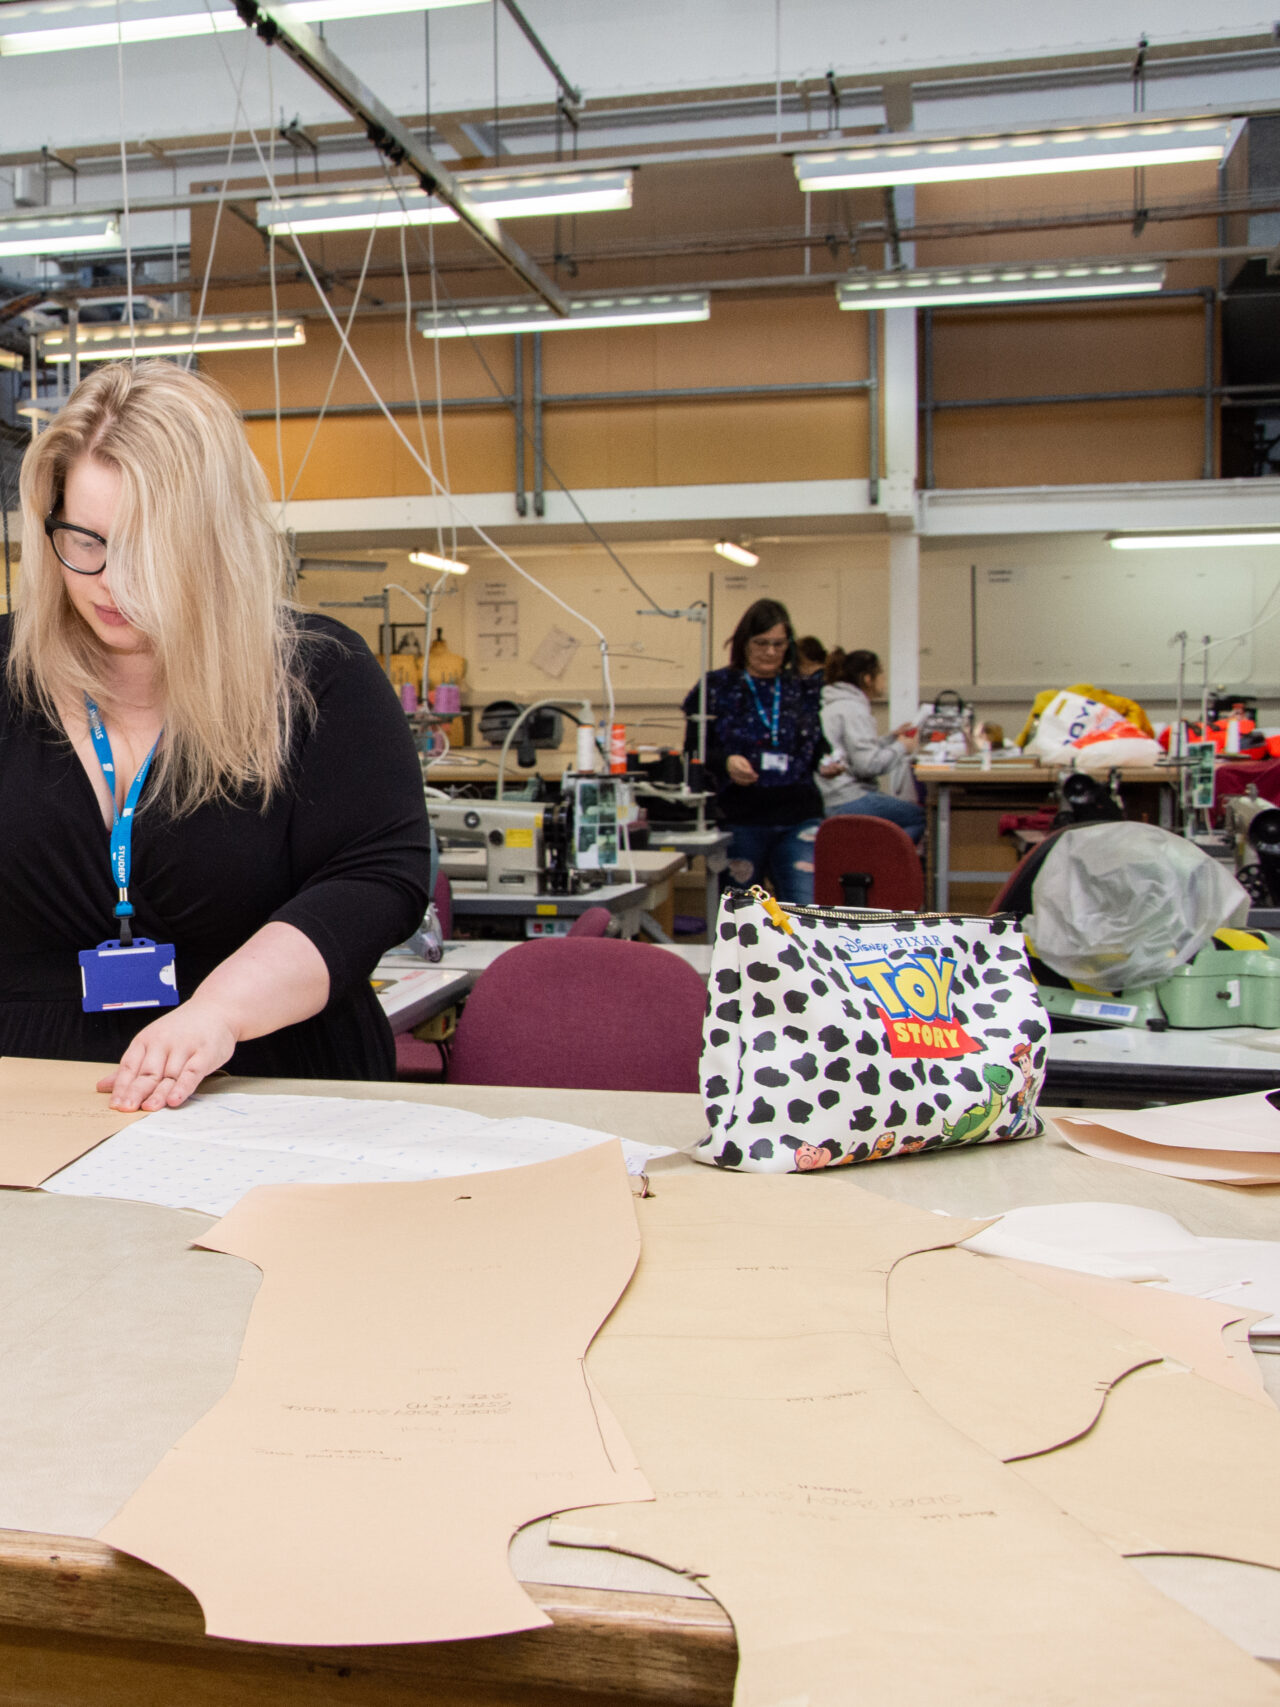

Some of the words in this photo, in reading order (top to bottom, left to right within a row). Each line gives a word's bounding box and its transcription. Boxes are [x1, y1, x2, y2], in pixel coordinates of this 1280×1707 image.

[117, 845, 127, 884] STUDENT
[893, 934, 944, 948] PIXAR
[844, 953, 958, 1022] TOY
[893, 1022, 960, 1049] STORY
